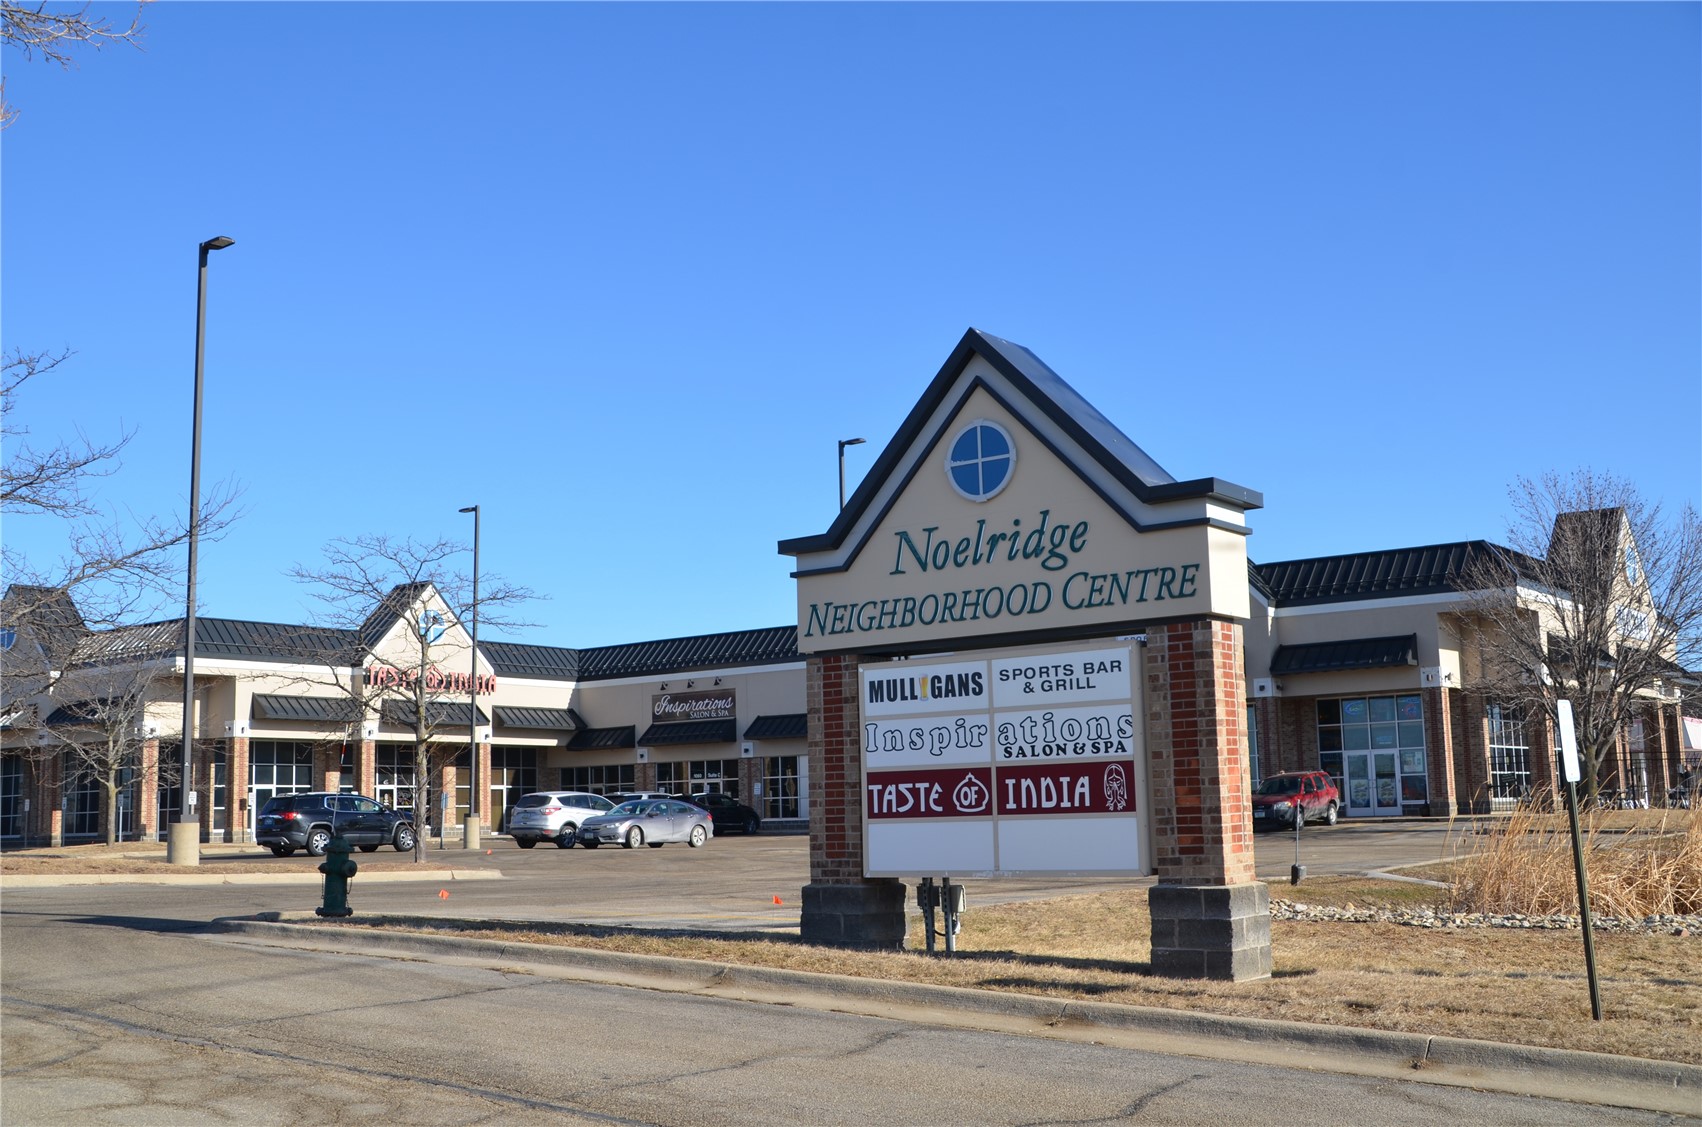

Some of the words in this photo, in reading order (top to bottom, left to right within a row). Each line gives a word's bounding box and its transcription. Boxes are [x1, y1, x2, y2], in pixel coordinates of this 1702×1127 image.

[889, 509, 1089, 575] Noelridge
[804, 581, 1052, 637] NEIGHBORHOOD
[1062, 563, 1200, 610] CENTRE
[999, 664, 1074, 682] SPORTS
[1083, 660, 1122, 675] BAR
[1023, 681, 1035, 694] &
[1040, 677, 1097, 693] GRILL
[654, 694, 734, 717] Inspirations
[690, 710, 710, 719] SALON
[711, 709, 717, 718] &
[718, 709, 729, 717] SPA
[1003, 743, 1068, 759] SALON
[1072, 742, 1087, 755] &
[1091, 739, 1128, 755] SPA
[869, 782, 944, 814] TASTE
[960, 786, 979, 806] OF
[1005, 776, 1091, 810] INDIA
